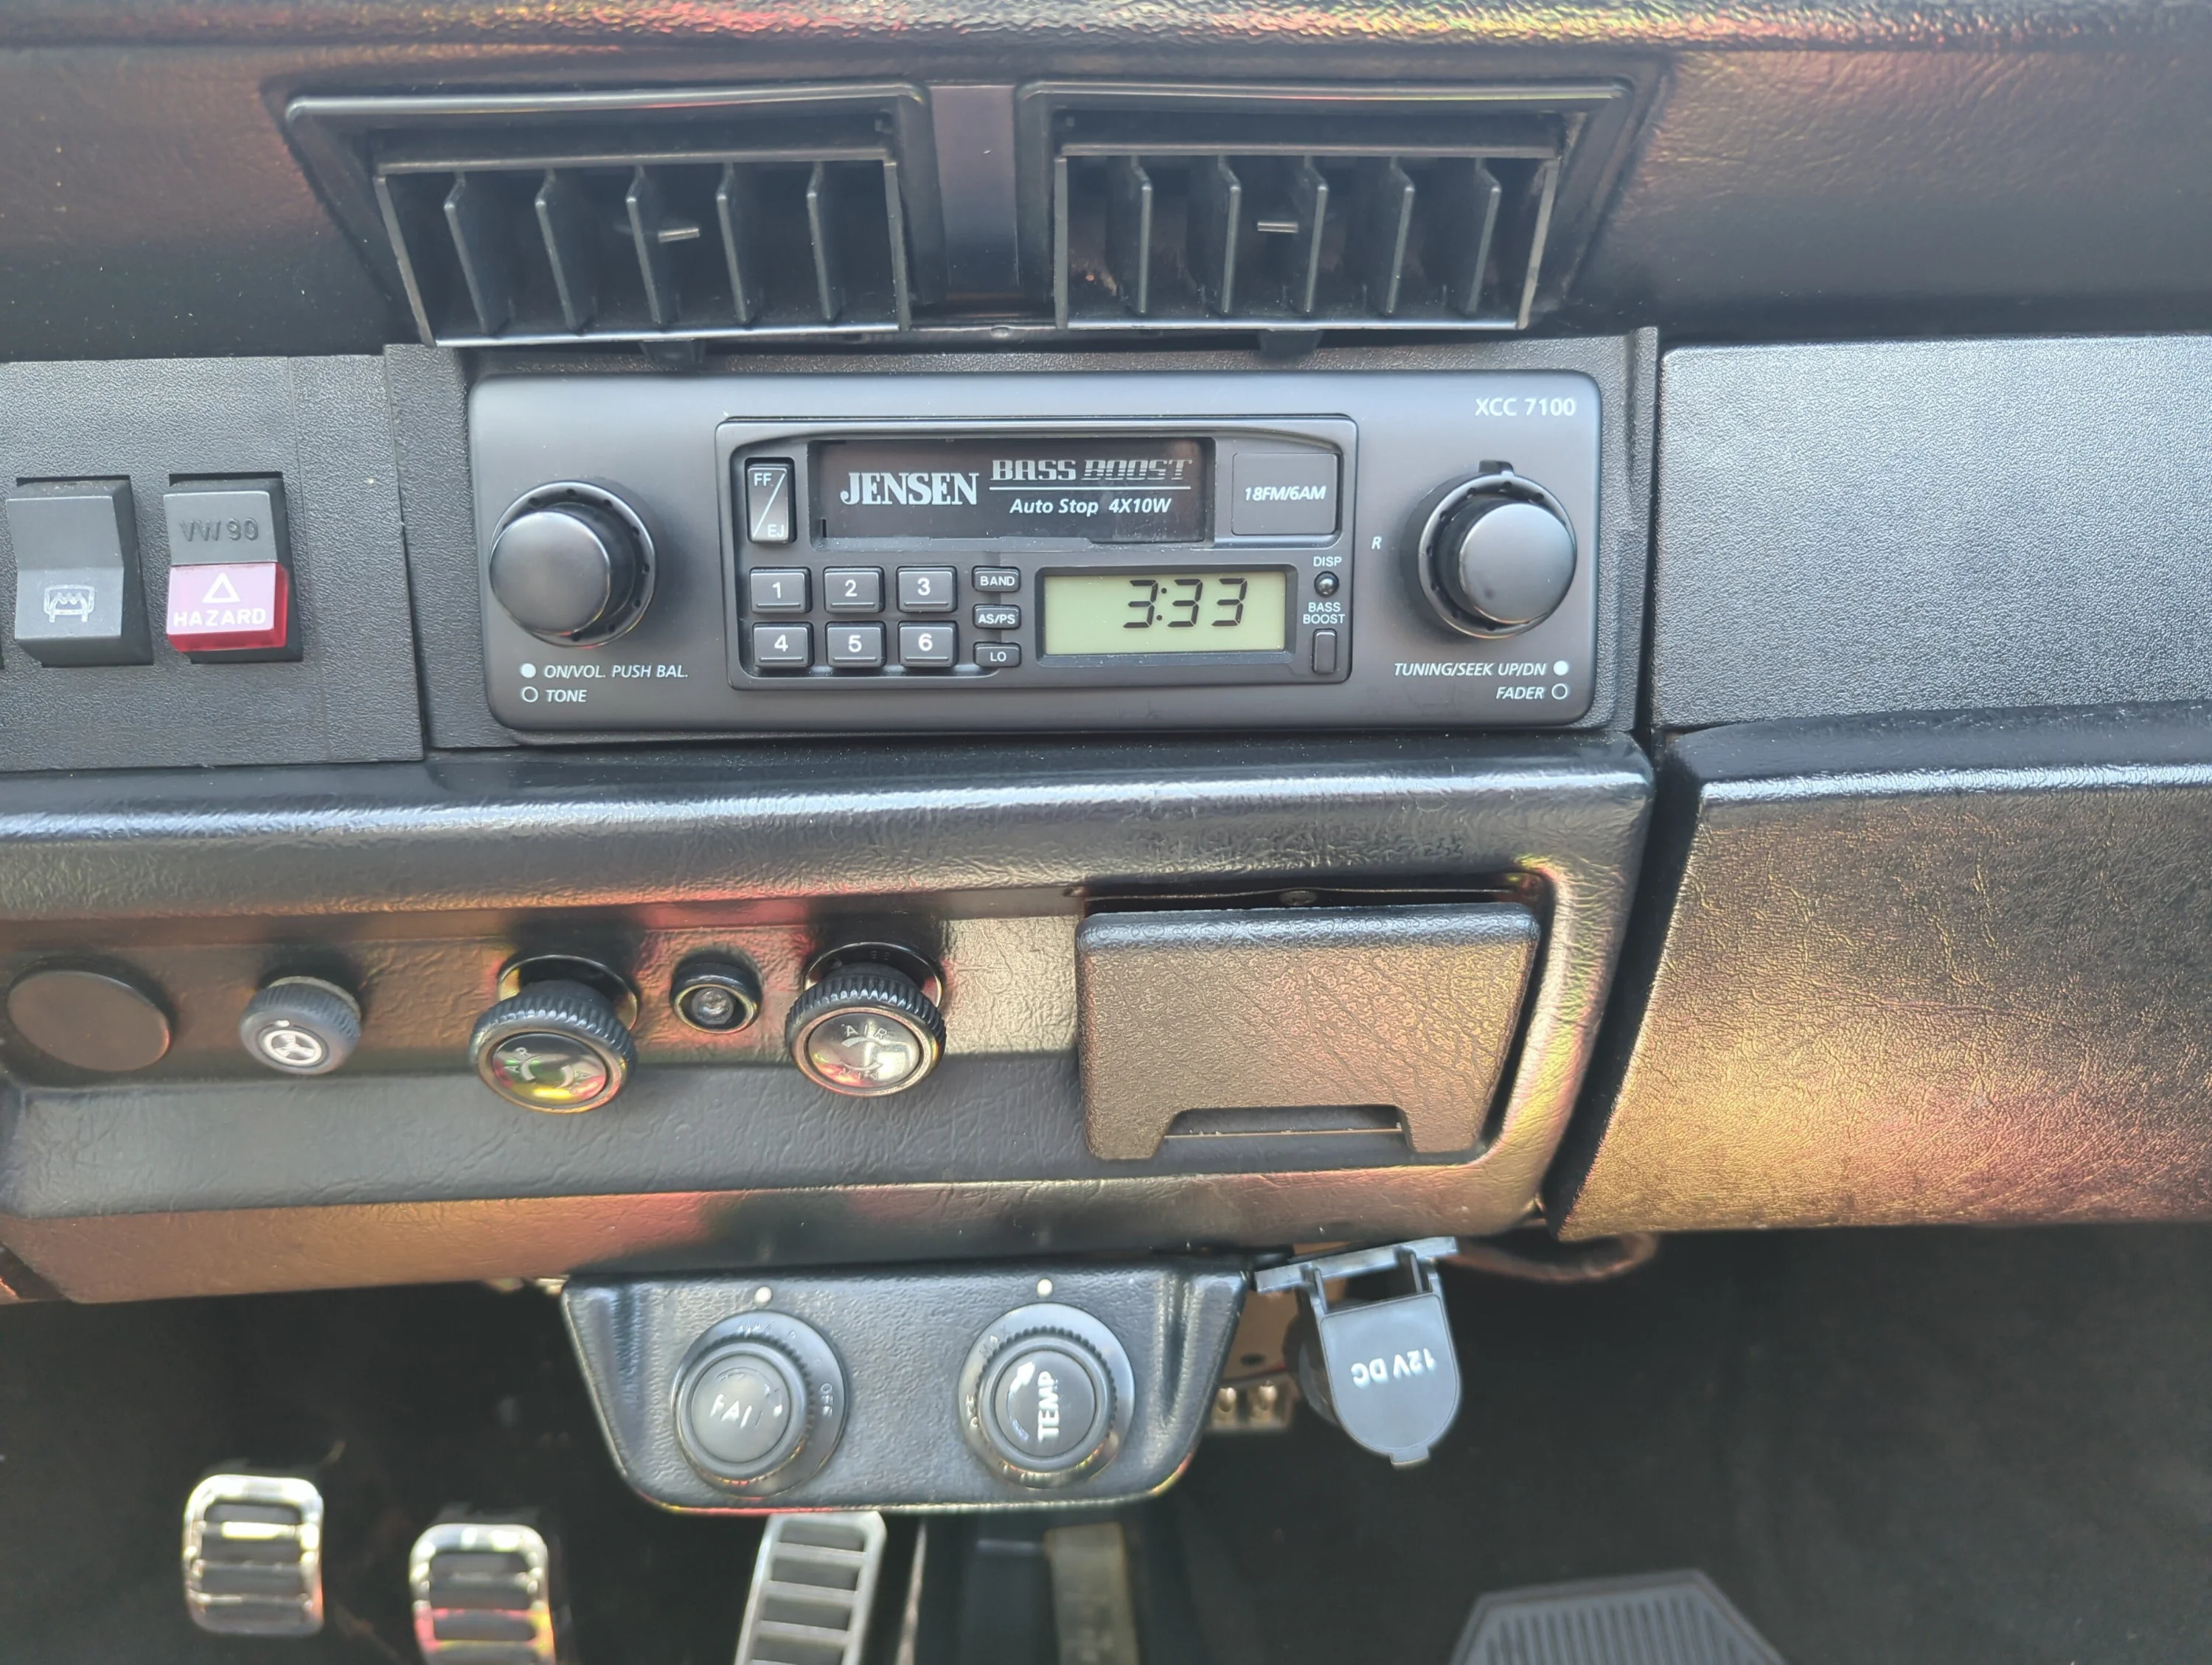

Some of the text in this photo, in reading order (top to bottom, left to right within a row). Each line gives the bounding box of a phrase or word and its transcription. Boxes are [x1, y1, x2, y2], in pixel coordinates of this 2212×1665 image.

[1475, 398, 1576, 417] XCC 7100
[990, 459, 1193, 481] BASS BOOST
[754, 473, 772, 486] FF
[840, 471, 979, 506] JENSEN
[1244, 484, 1326, 502] 18FM/6AM
[1009, 498, 1172, 517] Auto Stop 4X10W
[768, 524, 785, 538] EJ
[1371, 536, 1382, 550] R
[1312, 556, 1343, 567] DISP
[844, 580, 858, 598] 2
[917, 577, 931, 596] 3
[979, 575, 1015, 587] BAND
[772, 582, 782, 599] 1
[1122, 577, 1248, 629] 3:33
[1307, 602, 1341, 613] BASS
[173, 608, 266, 627] HAZARD
[978, 613, 1016, 625] AS/PS
[1302, 613, 1346, 625] BOOST
[773, 635, 789, 653] 4
[848, 635, 863, 653] 5
[918, 633, 933, 652] 6
[990, 651, 1007, 662] LO
[543, 664, 689, 679] ON/VOL. PUSH BAL.
[1394, 663, 1546, 677] TUNING/SEEK UP/DN
[545, 689, 588, 703] TONE
[1495, 686, 1545, 700] FADER
[845, 1023, 888, 1042] AIR
[1351, 1347, 1436, 1389] 12V DC
[1037, 1371, 1060, 1443] TEMP
